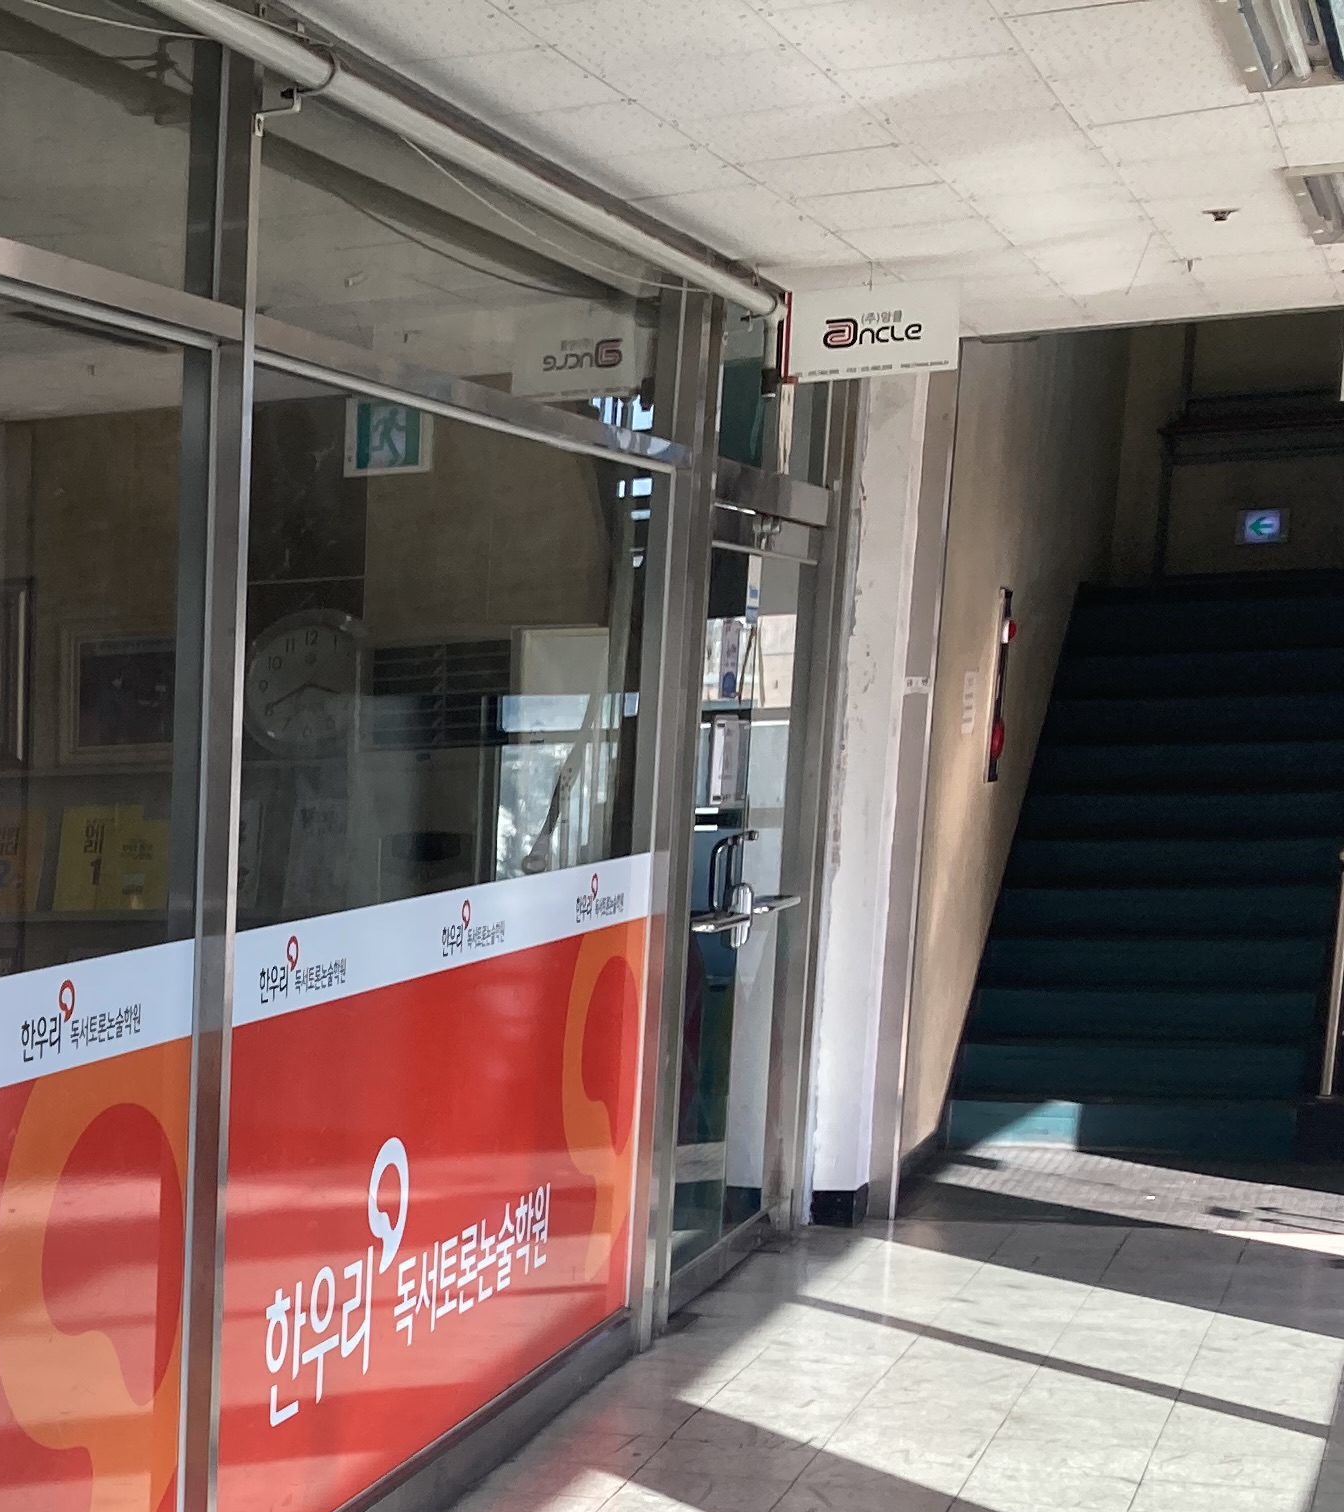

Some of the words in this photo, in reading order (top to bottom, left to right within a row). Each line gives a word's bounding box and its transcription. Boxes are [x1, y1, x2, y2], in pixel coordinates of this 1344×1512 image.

[259, 963, 289, 1005] 한우리
[294, 956, 347, 996] 독서토론논술학원
[20, 1012, 62, 1063] 한우리
[70, 1003, 142, 1048] 독서토론논술학원
[265, 1244, 374, 1428] 한우리
[393, 1182, 552, 1348] 독서토론논술학원
